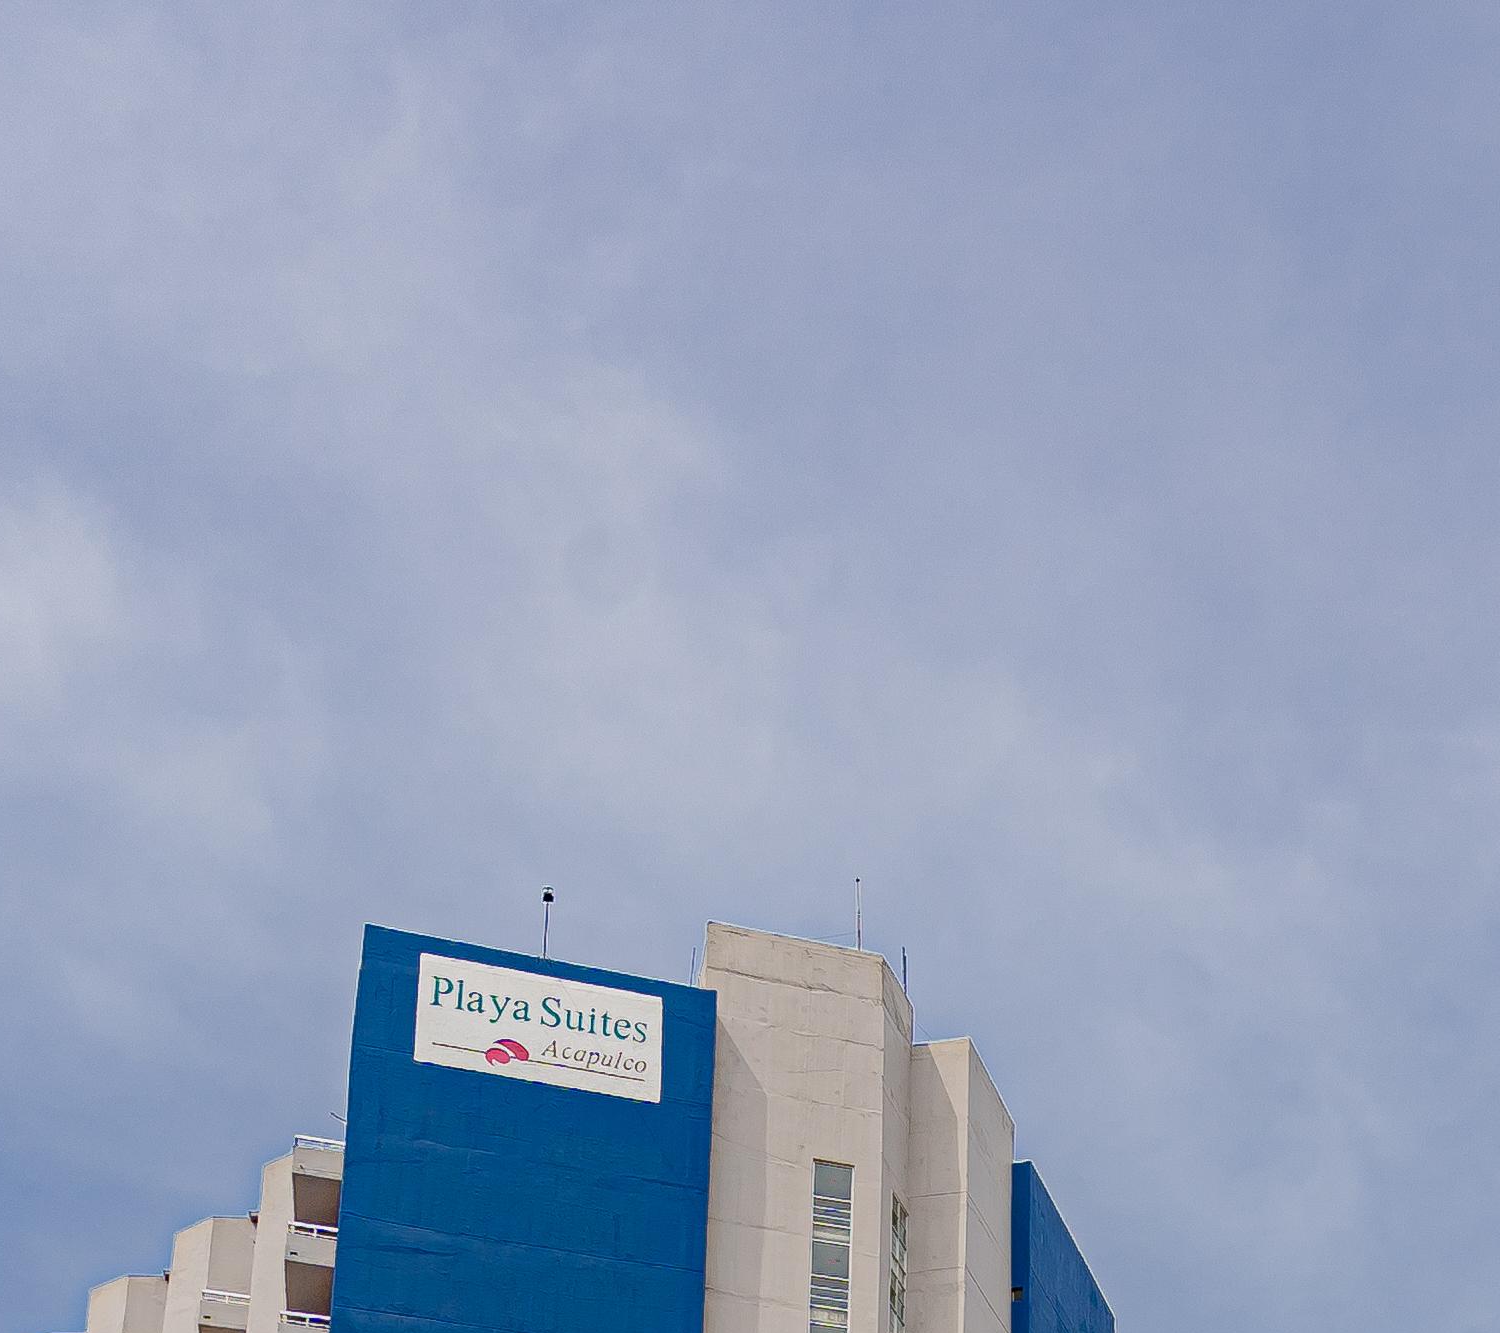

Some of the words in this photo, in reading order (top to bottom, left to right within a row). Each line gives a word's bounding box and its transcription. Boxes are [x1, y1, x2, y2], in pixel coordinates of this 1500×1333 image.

[429, 975, 531, 1024] Playa
[540, 996, 648, 1044] Suites
[542, 1040, 648, 1074] Acapulco
